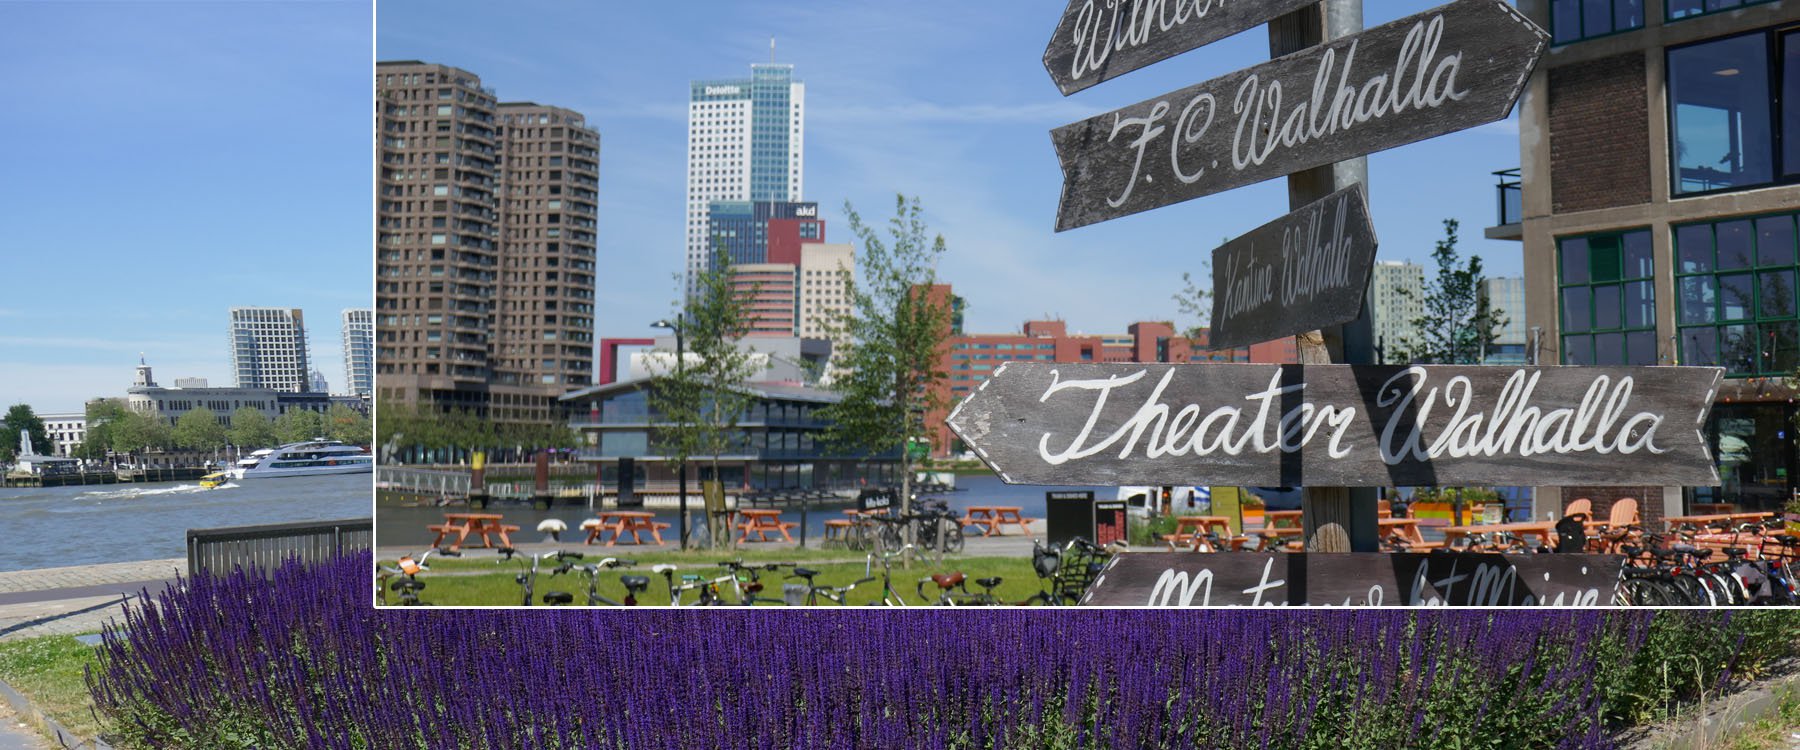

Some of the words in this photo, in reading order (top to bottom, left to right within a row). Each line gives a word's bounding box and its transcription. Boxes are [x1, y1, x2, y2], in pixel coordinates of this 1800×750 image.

[705, 85, 741, 96] Deloitte
[1107, 93, 1218, 208] F.C.
[1232, 14, 1469, 171] Walhalla
[795, 206, 816, 217] akd
[1220, 241, 1273, 332] Kantine
[1281, 193, 1353, 307] Walhalla
[1038, 366, 1357, 465] Theater
[1376, 365, 1676, 465] Walhalla
